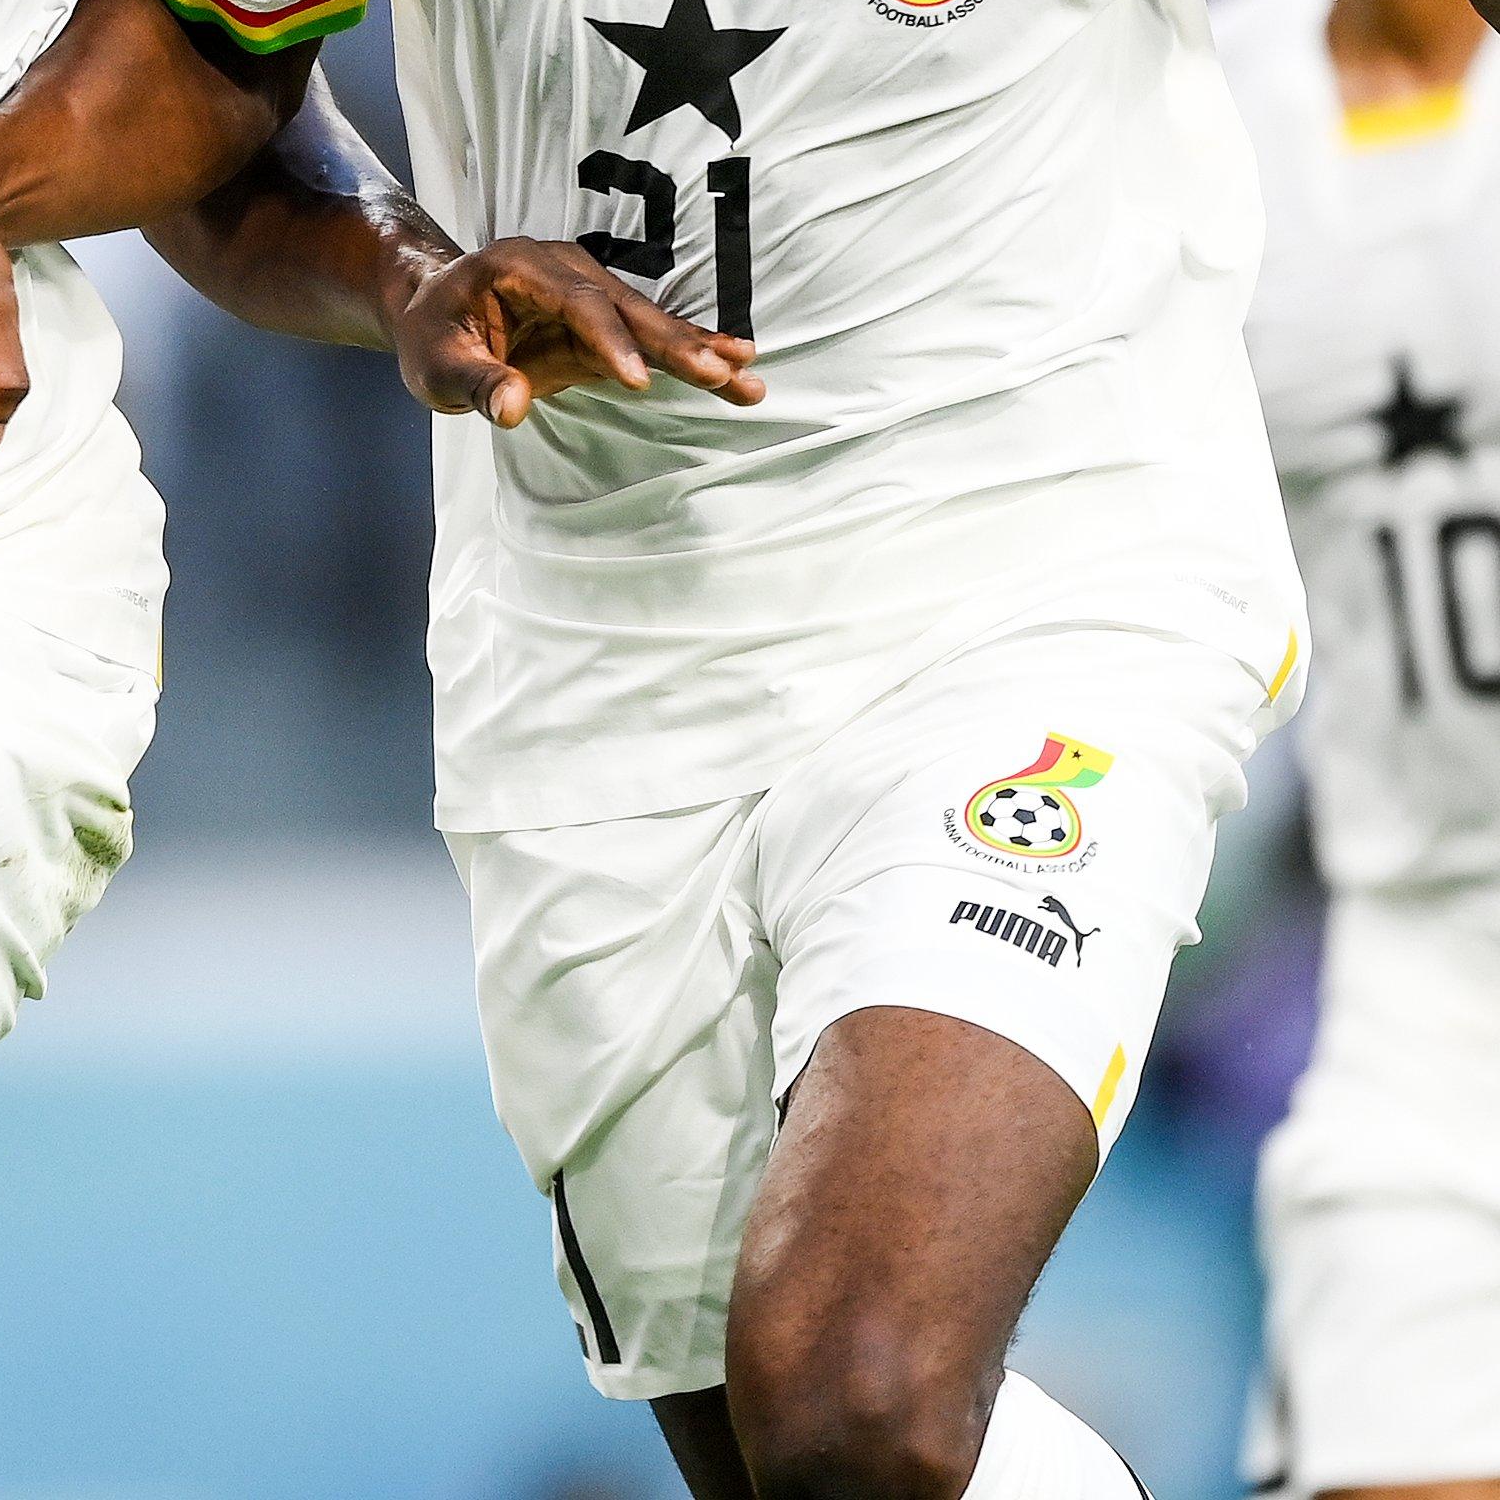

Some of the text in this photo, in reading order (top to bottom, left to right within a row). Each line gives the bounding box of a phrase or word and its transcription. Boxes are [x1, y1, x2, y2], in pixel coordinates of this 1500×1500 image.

[576, 148, 755, 342] 21
[1372, 510, 1500, 714] 10
[943, 808, 961, 844] GHANA
[949, 900, 1068, 968] PUMA
